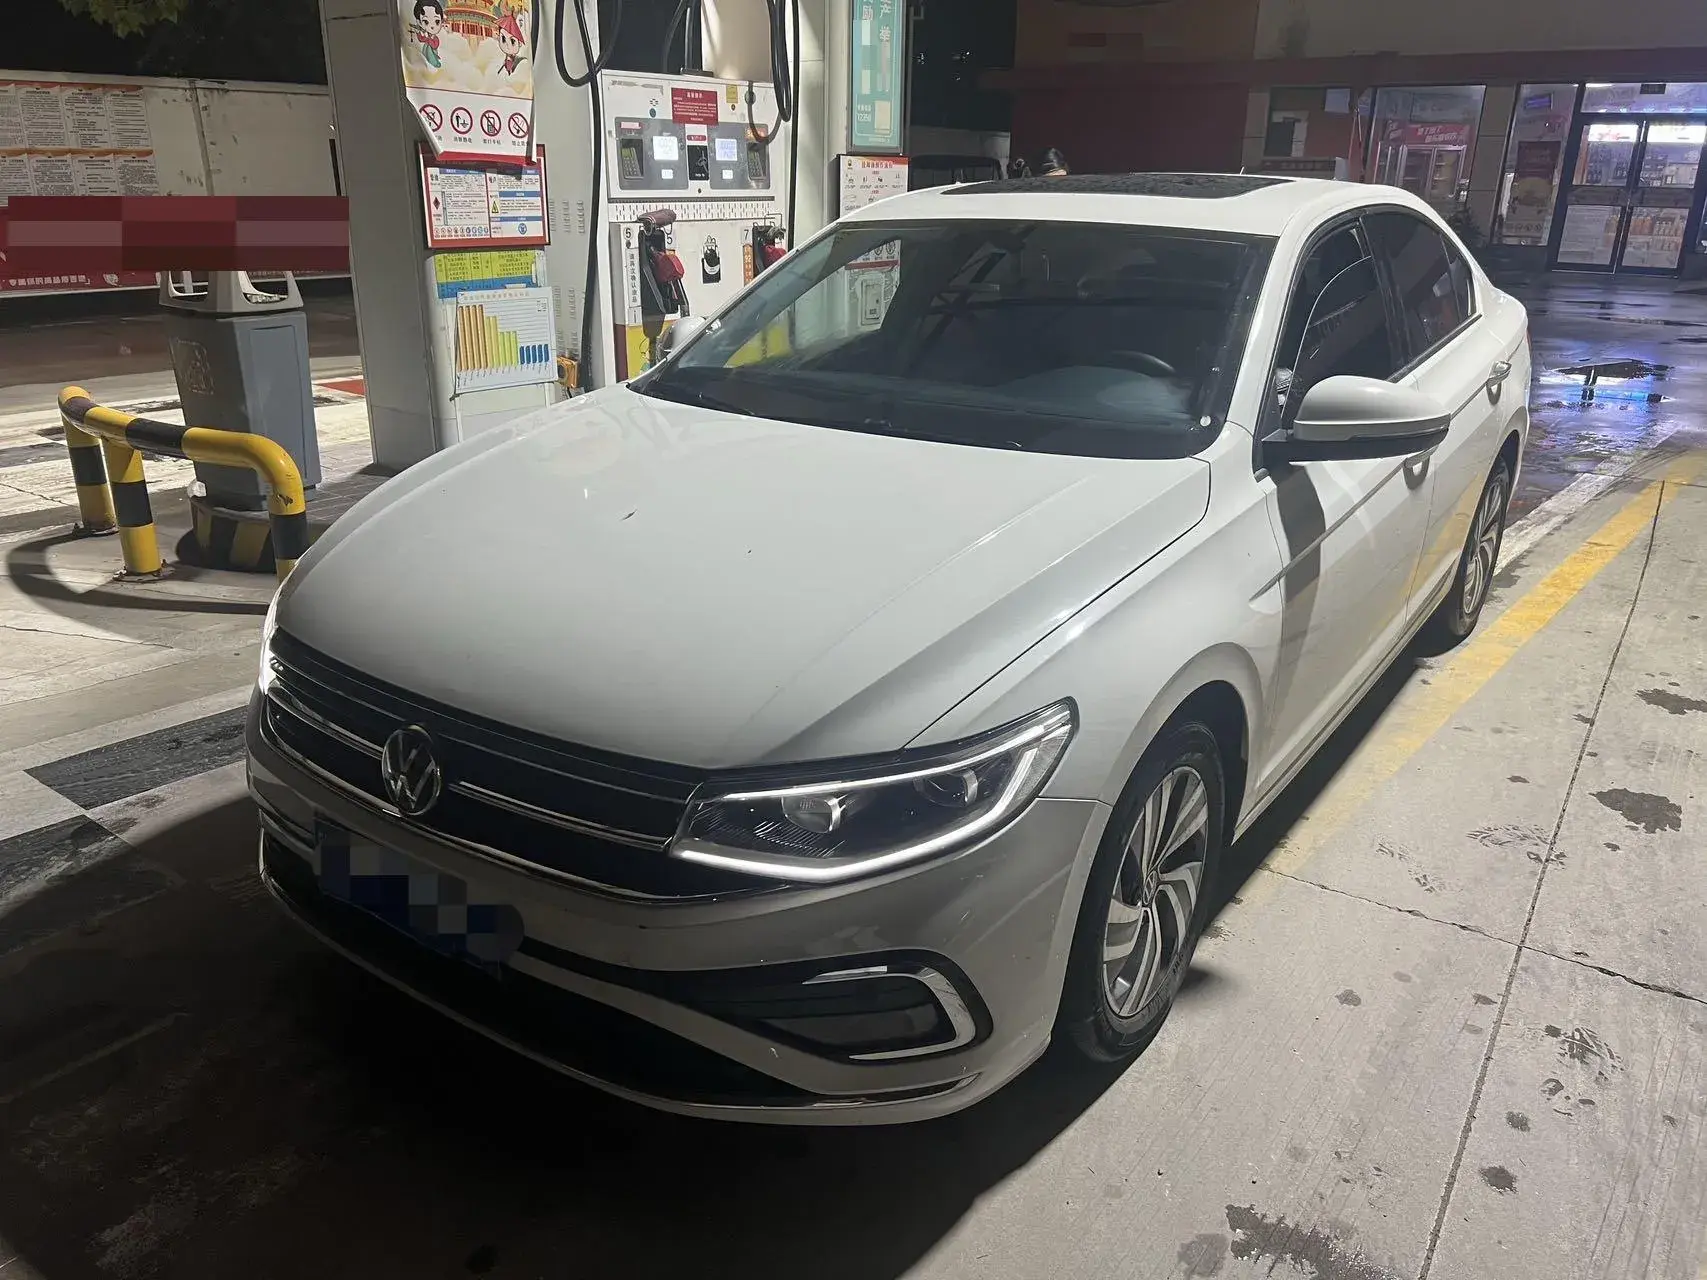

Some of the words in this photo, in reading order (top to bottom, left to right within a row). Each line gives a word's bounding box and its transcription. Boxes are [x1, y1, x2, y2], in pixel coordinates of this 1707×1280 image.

[625, 227, 632, 238] 5
[743, 229, 749, 239] 7
[666, 233, 673, 245] 5
